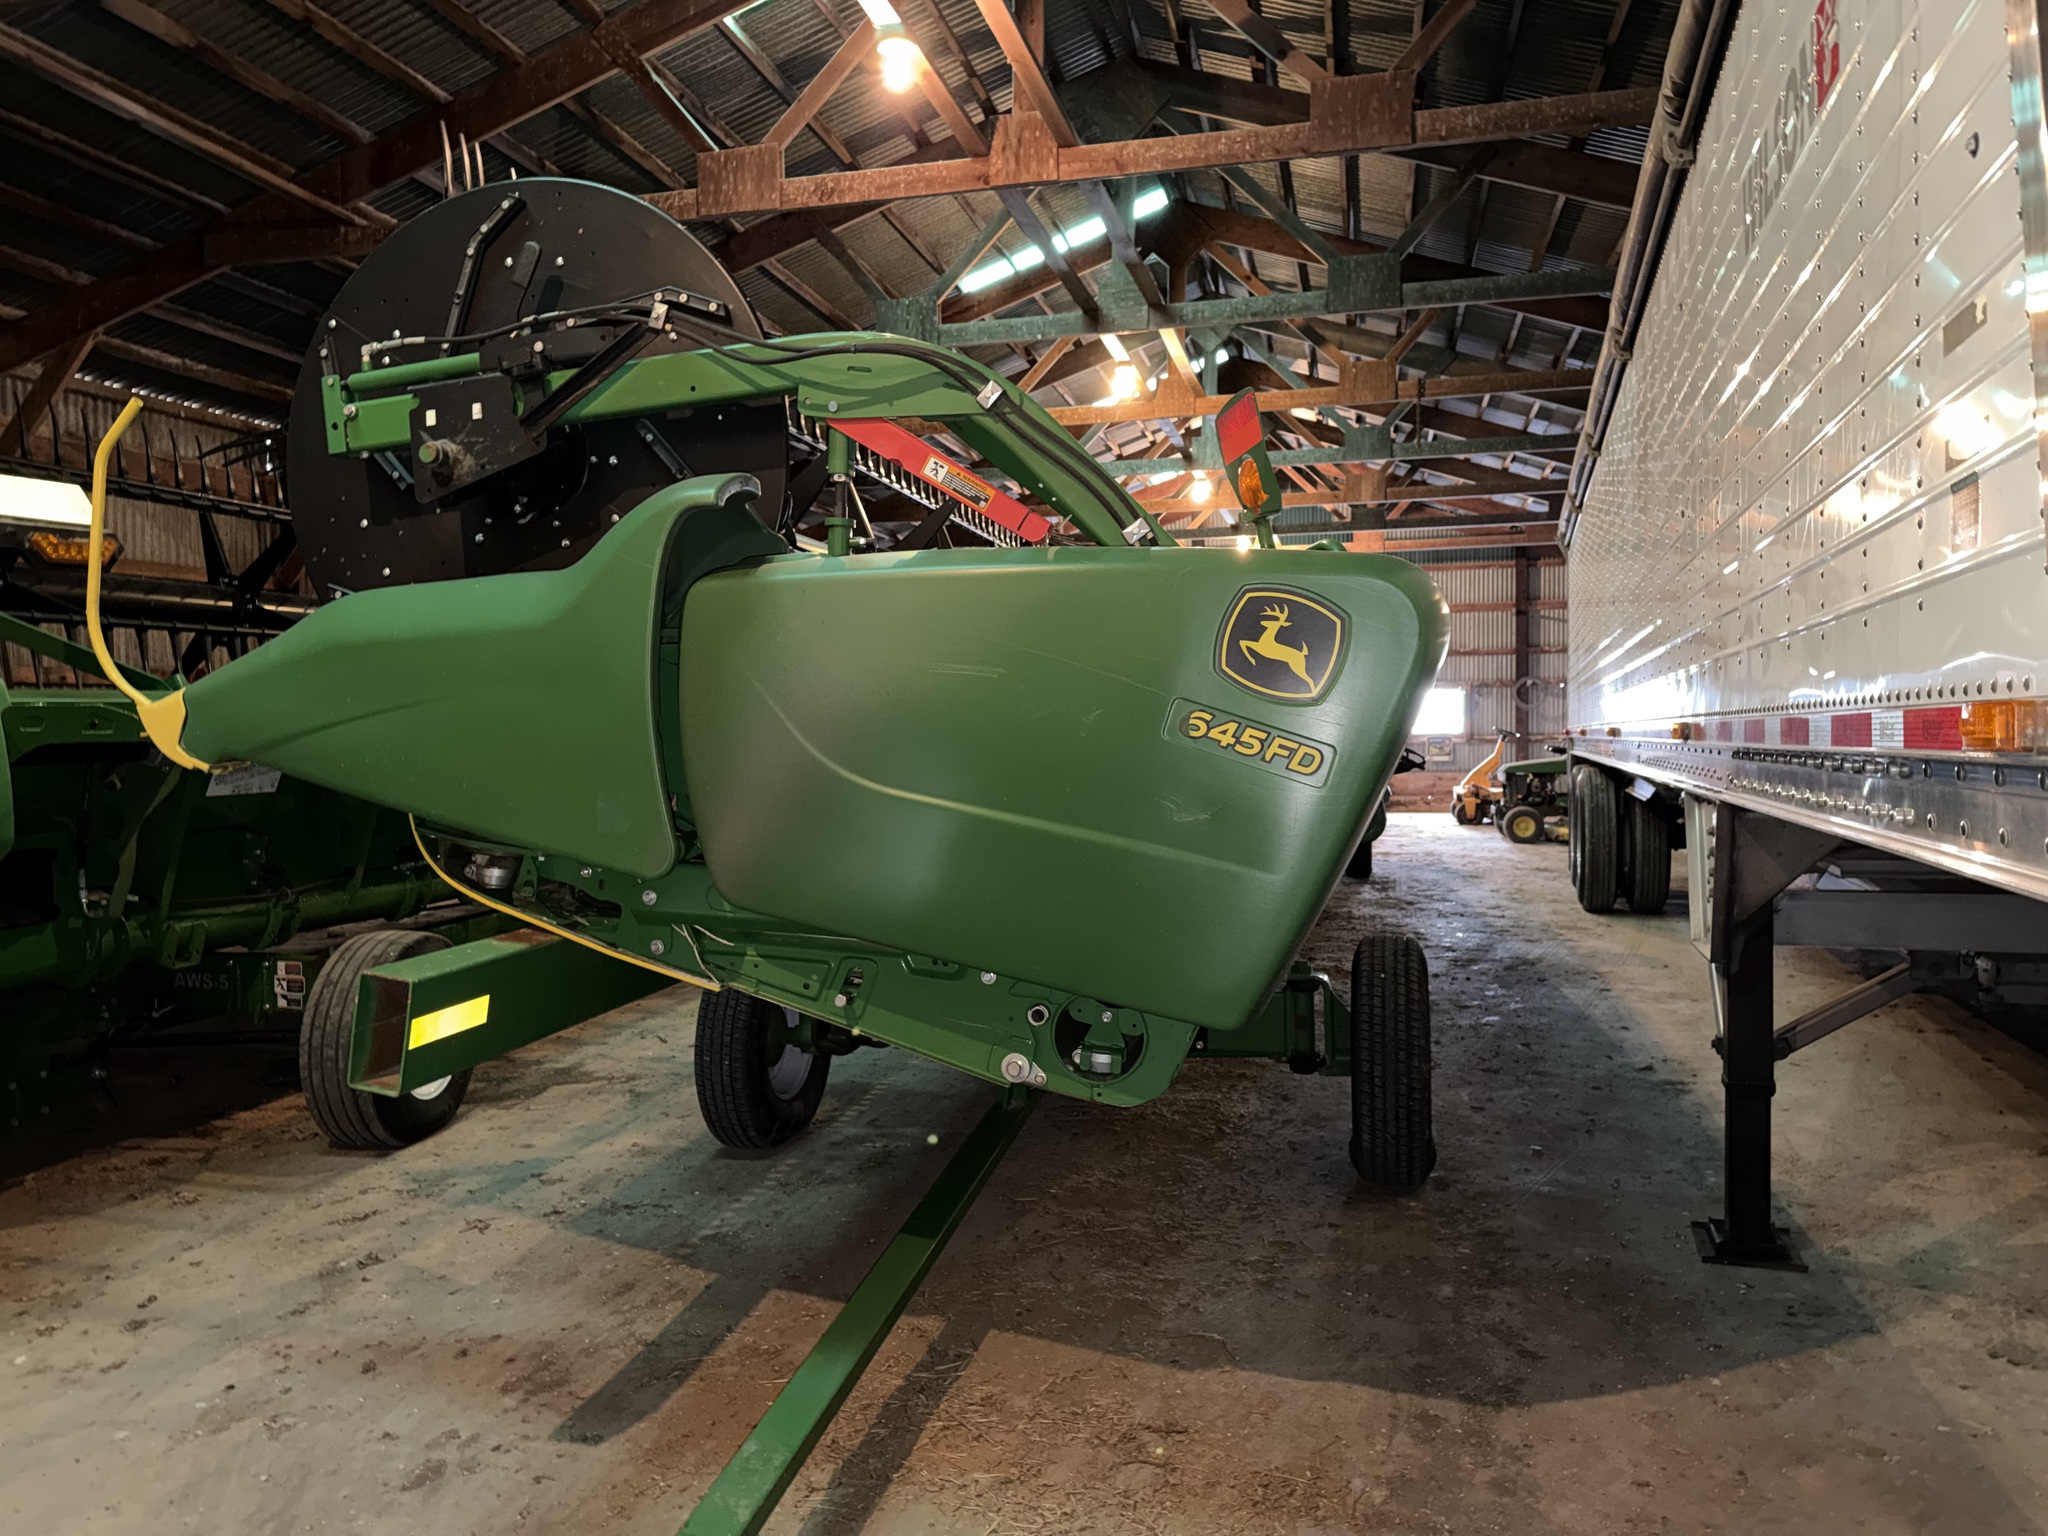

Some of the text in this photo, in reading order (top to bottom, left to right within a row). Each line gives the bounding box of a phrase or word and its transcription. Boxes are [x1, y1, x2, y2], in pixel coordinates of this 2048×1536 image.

[962, 473, 988, 492] WARNING
[1179, 709, 1324, 776] 645FD
[174, 972, 229, 990] AWS-5
